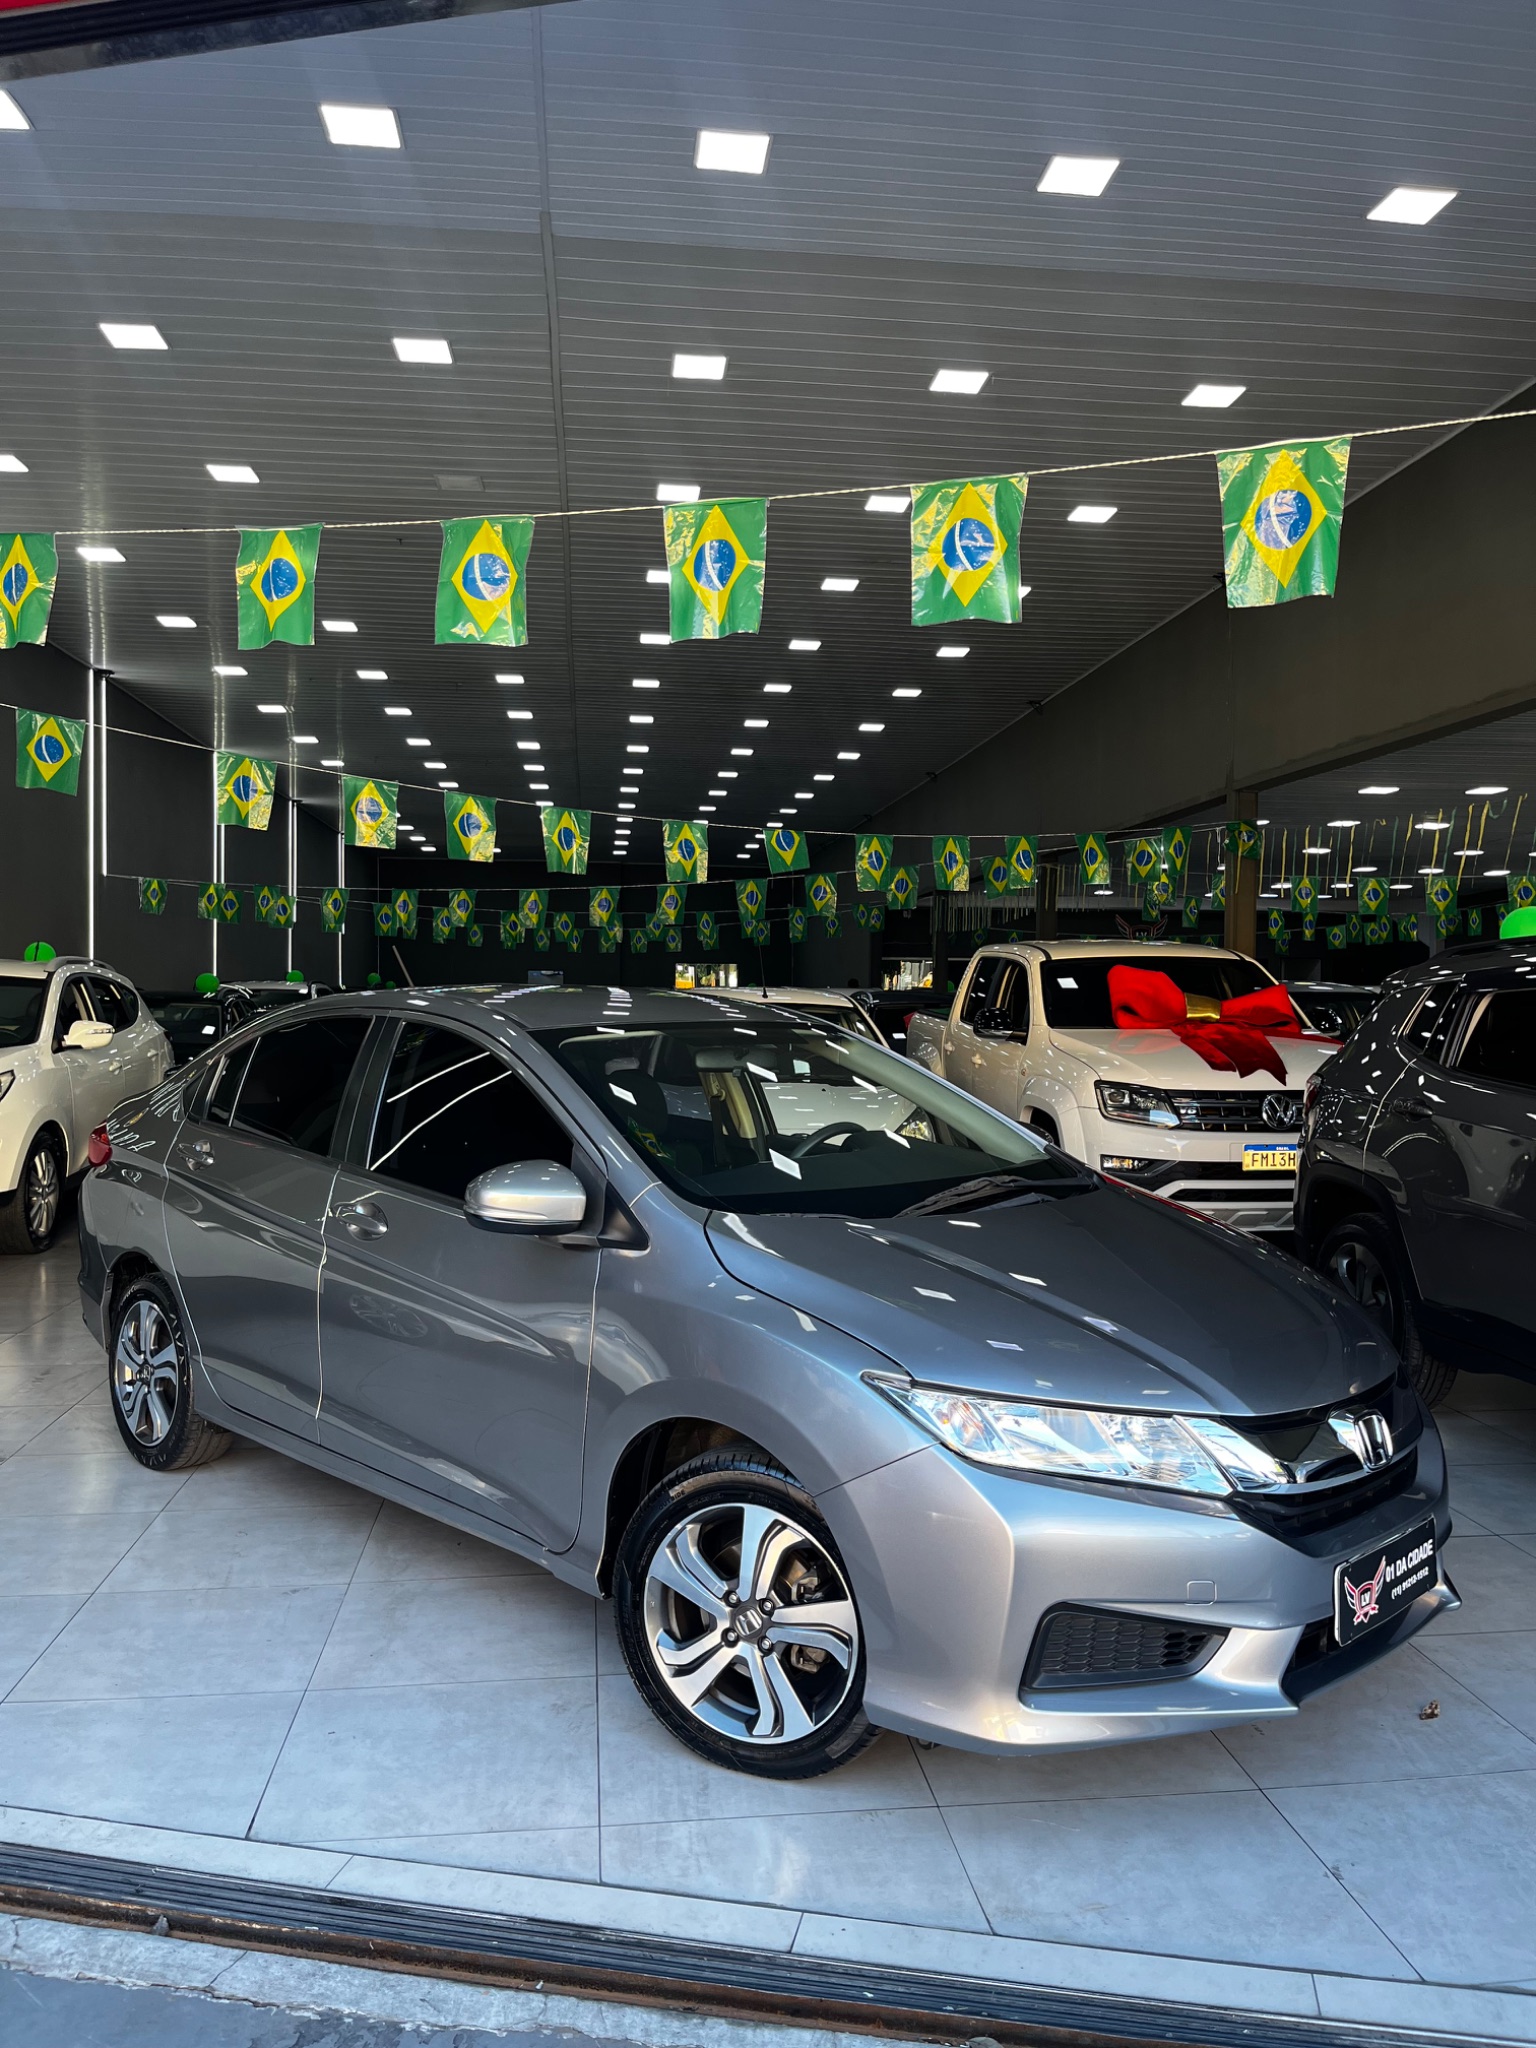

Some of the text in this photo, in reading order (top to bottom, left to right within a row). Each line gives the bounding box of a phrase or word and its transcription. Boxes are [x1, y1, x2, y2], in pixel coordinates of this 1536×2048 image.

[658, 1488, 686, 1511] OUTSIDE
[1385, 1538, 1434, 1583] 01 DA CIDADE
[1391, 1584, 1402, 1600] (11)
